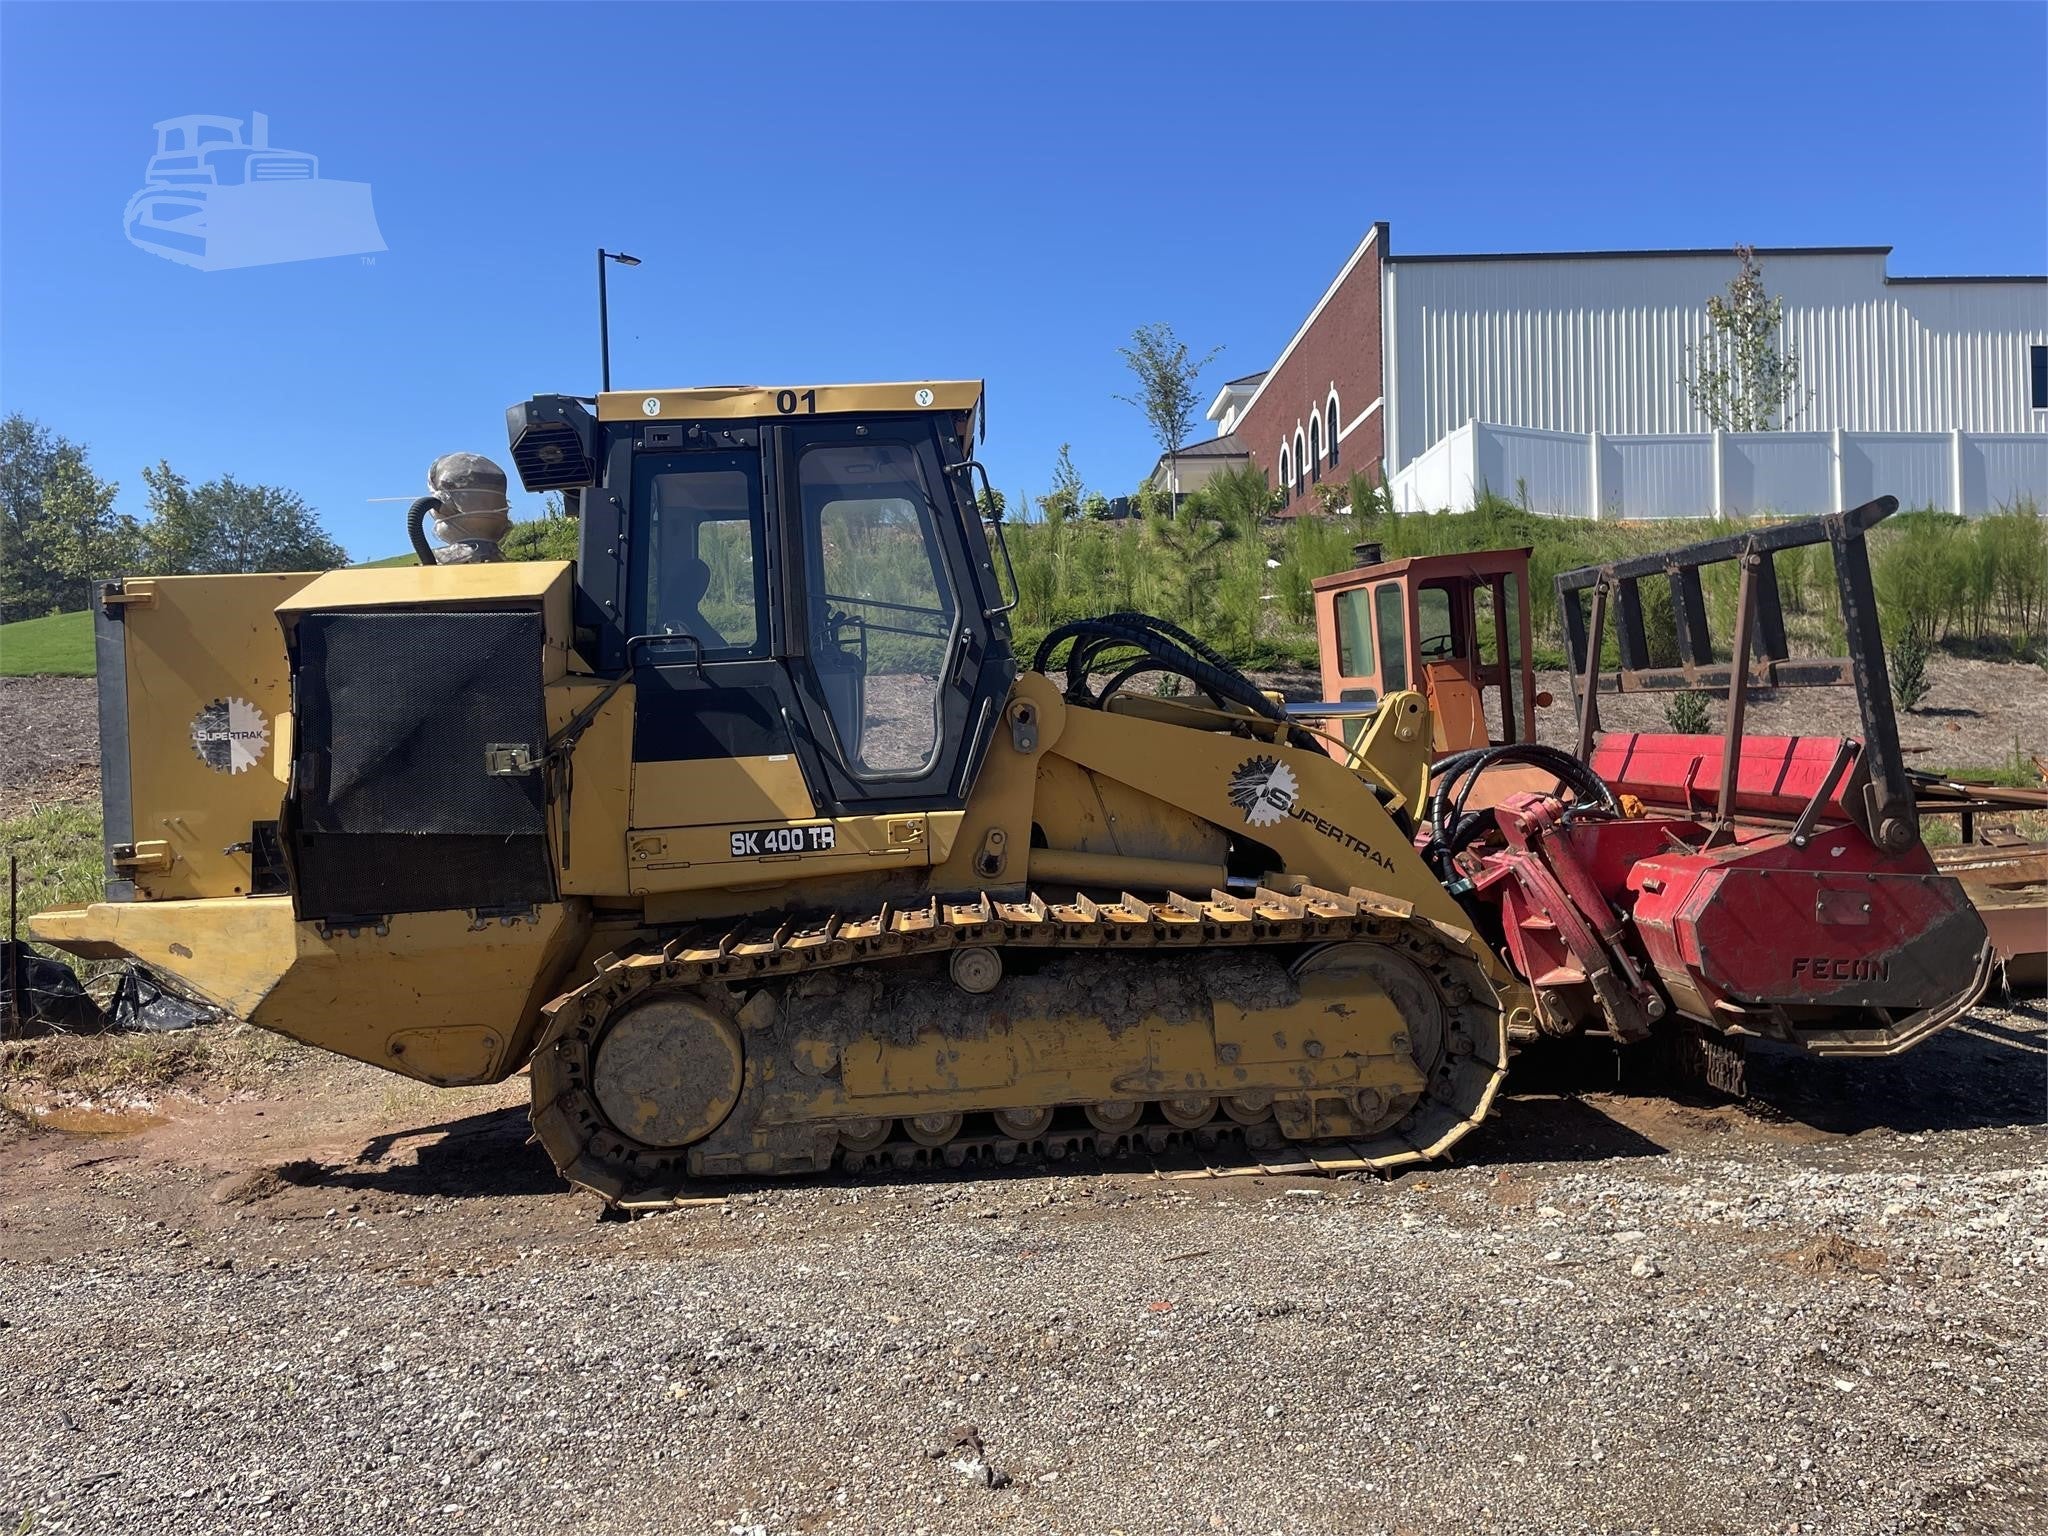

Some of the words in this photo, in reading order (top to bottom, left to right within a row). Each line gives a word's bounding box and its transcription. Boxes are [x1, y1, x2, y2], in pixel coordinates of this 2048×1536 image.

[776, 389, 816, 414] 01
[197, 729, 263, 741] SUPERTRAK
[731, 832, 760, 855] SK
[764, 828, 804, 852] 400
[808, 826, 836, 849] TR
[1267, 787, 1396, 874] SUPERTRAK
[1792, 958, 1890, 983] FECON
